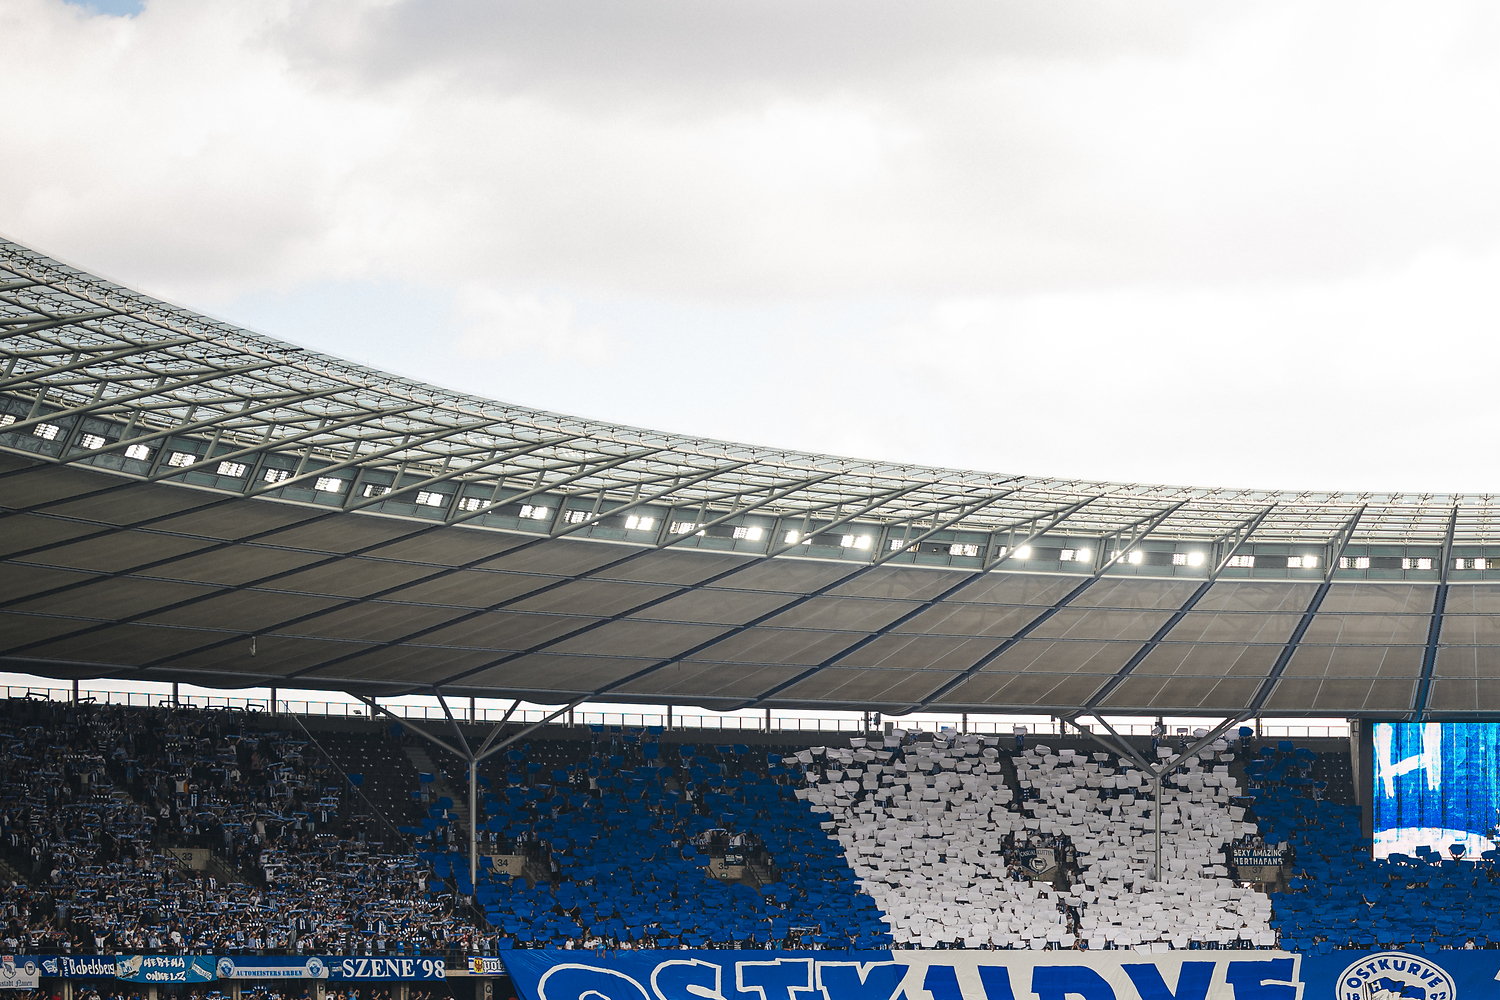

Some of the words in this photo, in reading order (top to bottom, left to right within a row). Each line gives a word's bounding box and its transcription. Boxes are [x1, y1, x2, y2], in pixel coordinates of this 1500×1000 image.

[69, 958, 115, 974] Babelsberg
[1347, 959, 1443, 988] OSTKURVE
[1346, 992, 1360, 1000] 18
[1430, 992, 1446, 1000] 92
